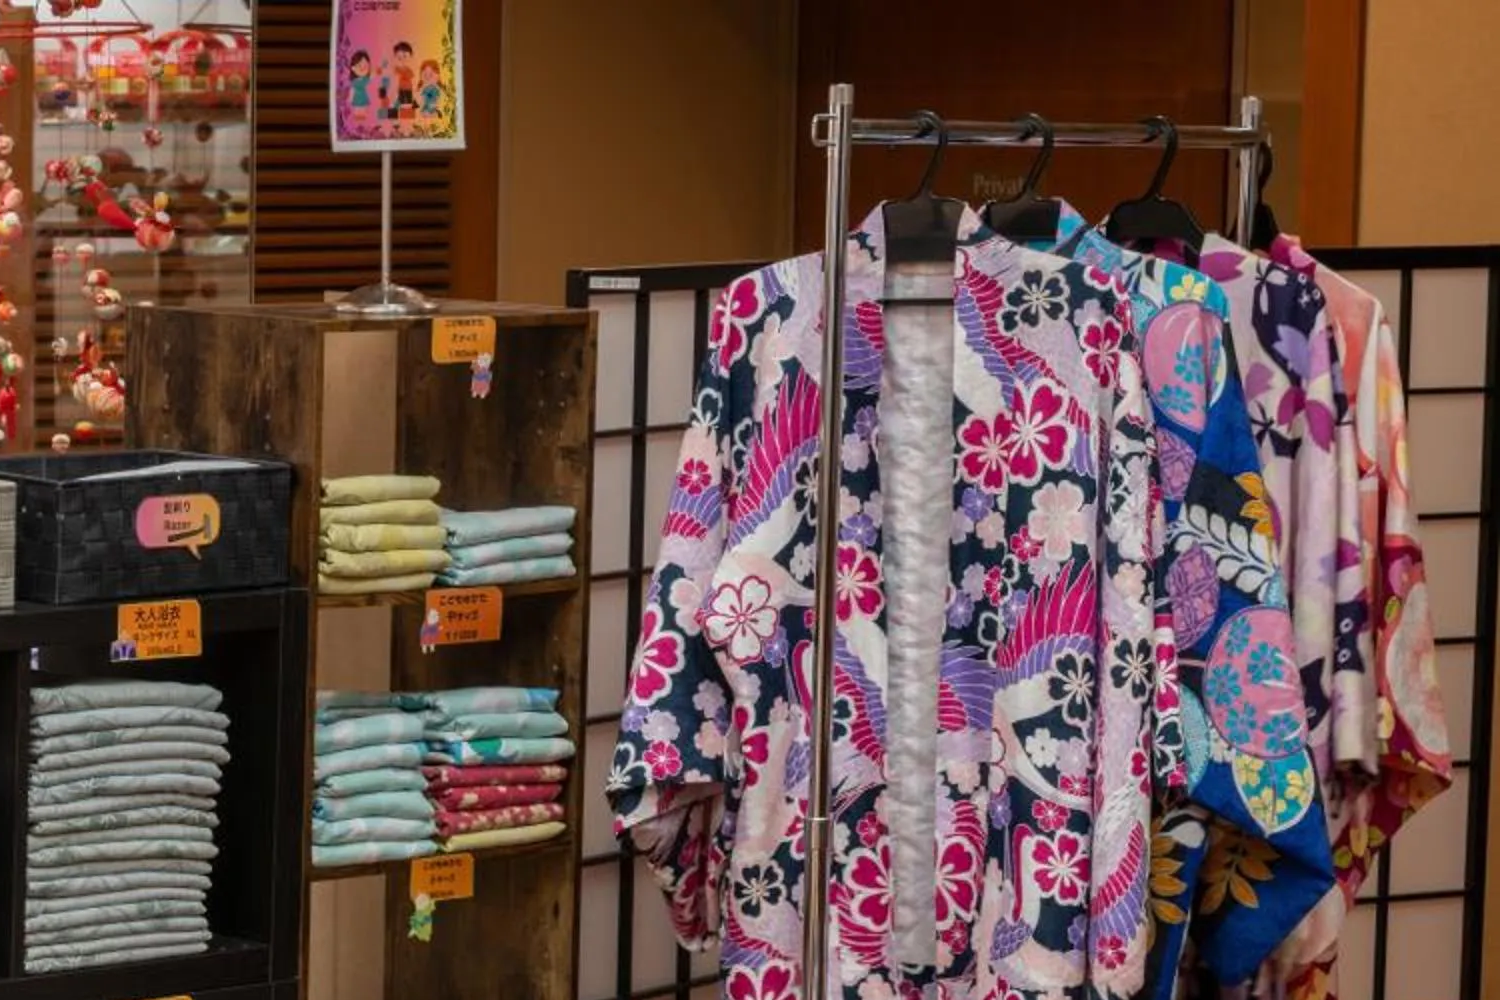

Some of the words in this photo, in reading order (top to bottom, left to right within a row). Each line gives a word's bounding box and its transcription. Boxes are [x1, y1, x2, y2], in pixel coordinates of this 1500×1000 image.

[973, 173, 1035, 196] Privat
[133, 604, 181, 622] 大人浴衣
